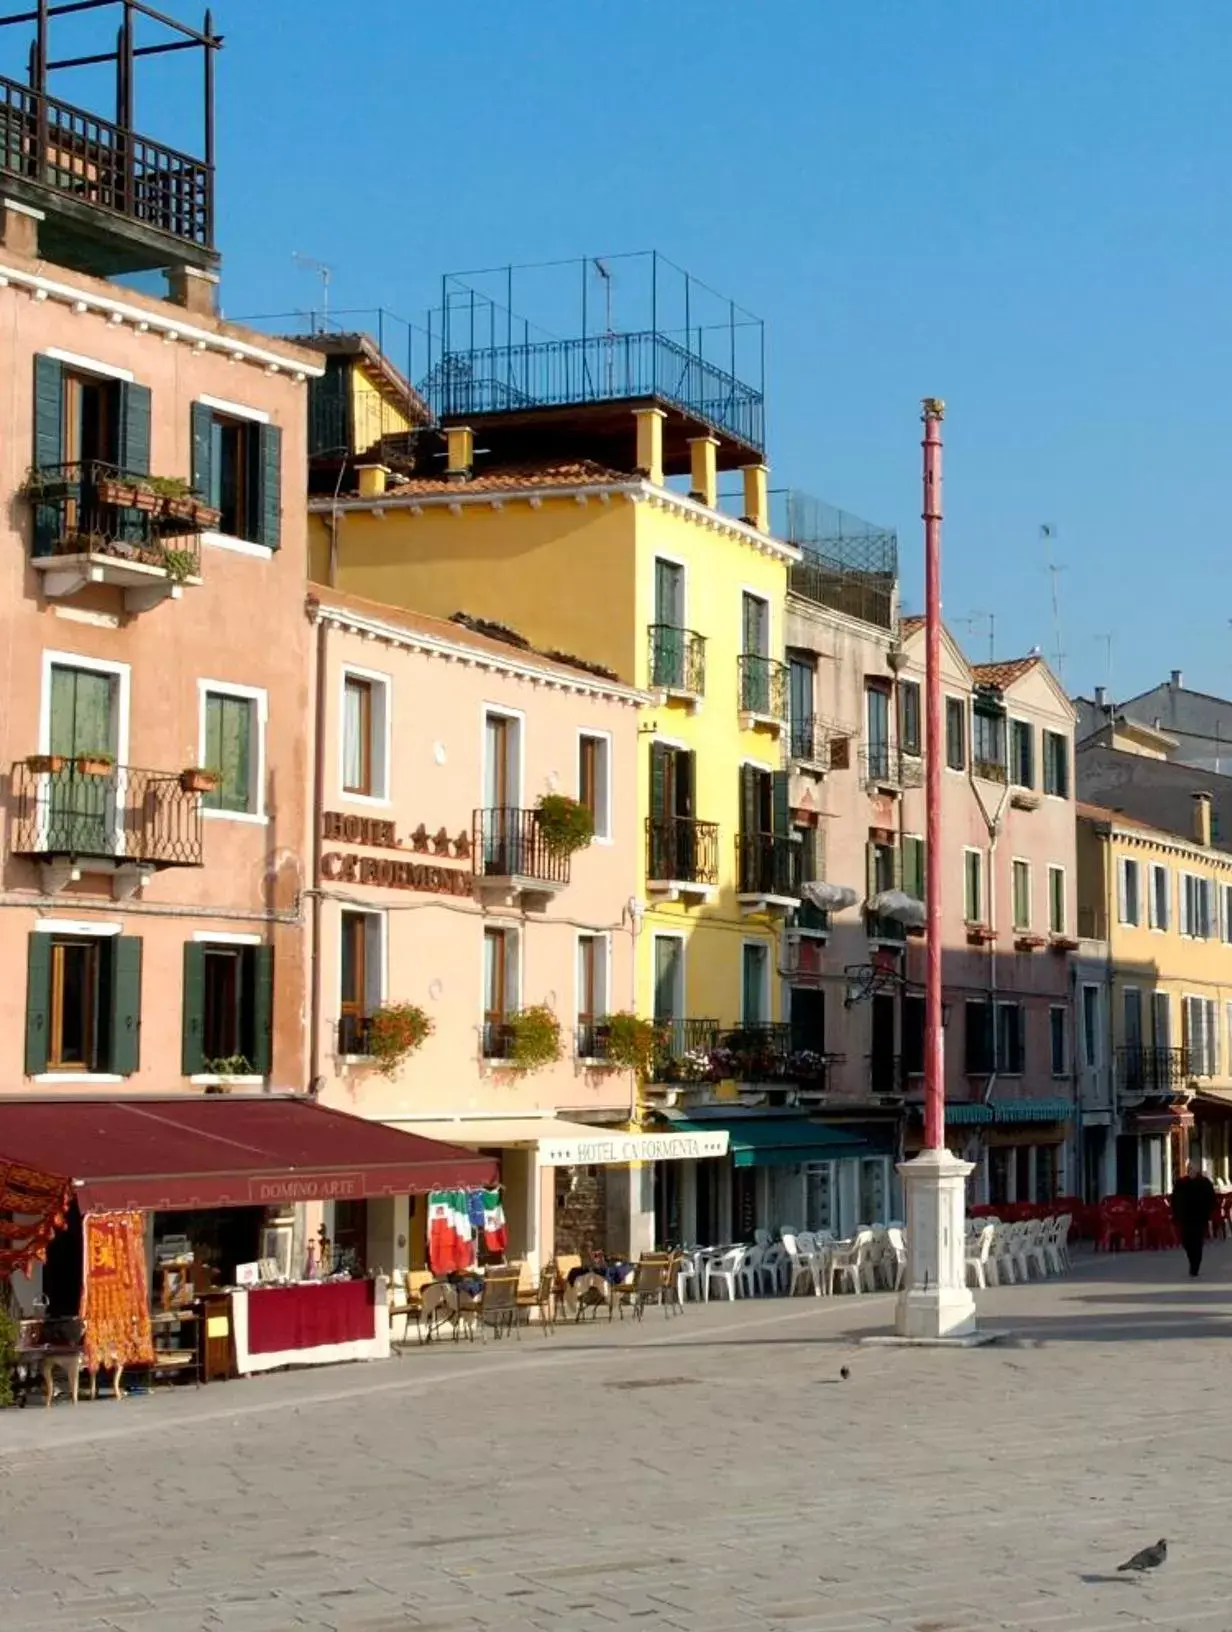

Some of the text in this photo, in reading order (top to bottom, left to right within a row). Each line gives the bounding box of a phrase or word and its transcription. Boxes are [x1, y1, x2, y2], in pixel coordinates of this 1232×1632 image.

[324, 811, 403, 848] HOTEL
[578, 1142, 617, 1161] HOTEL
[261, 1181, 355, 1199] DOMINO ARTE
